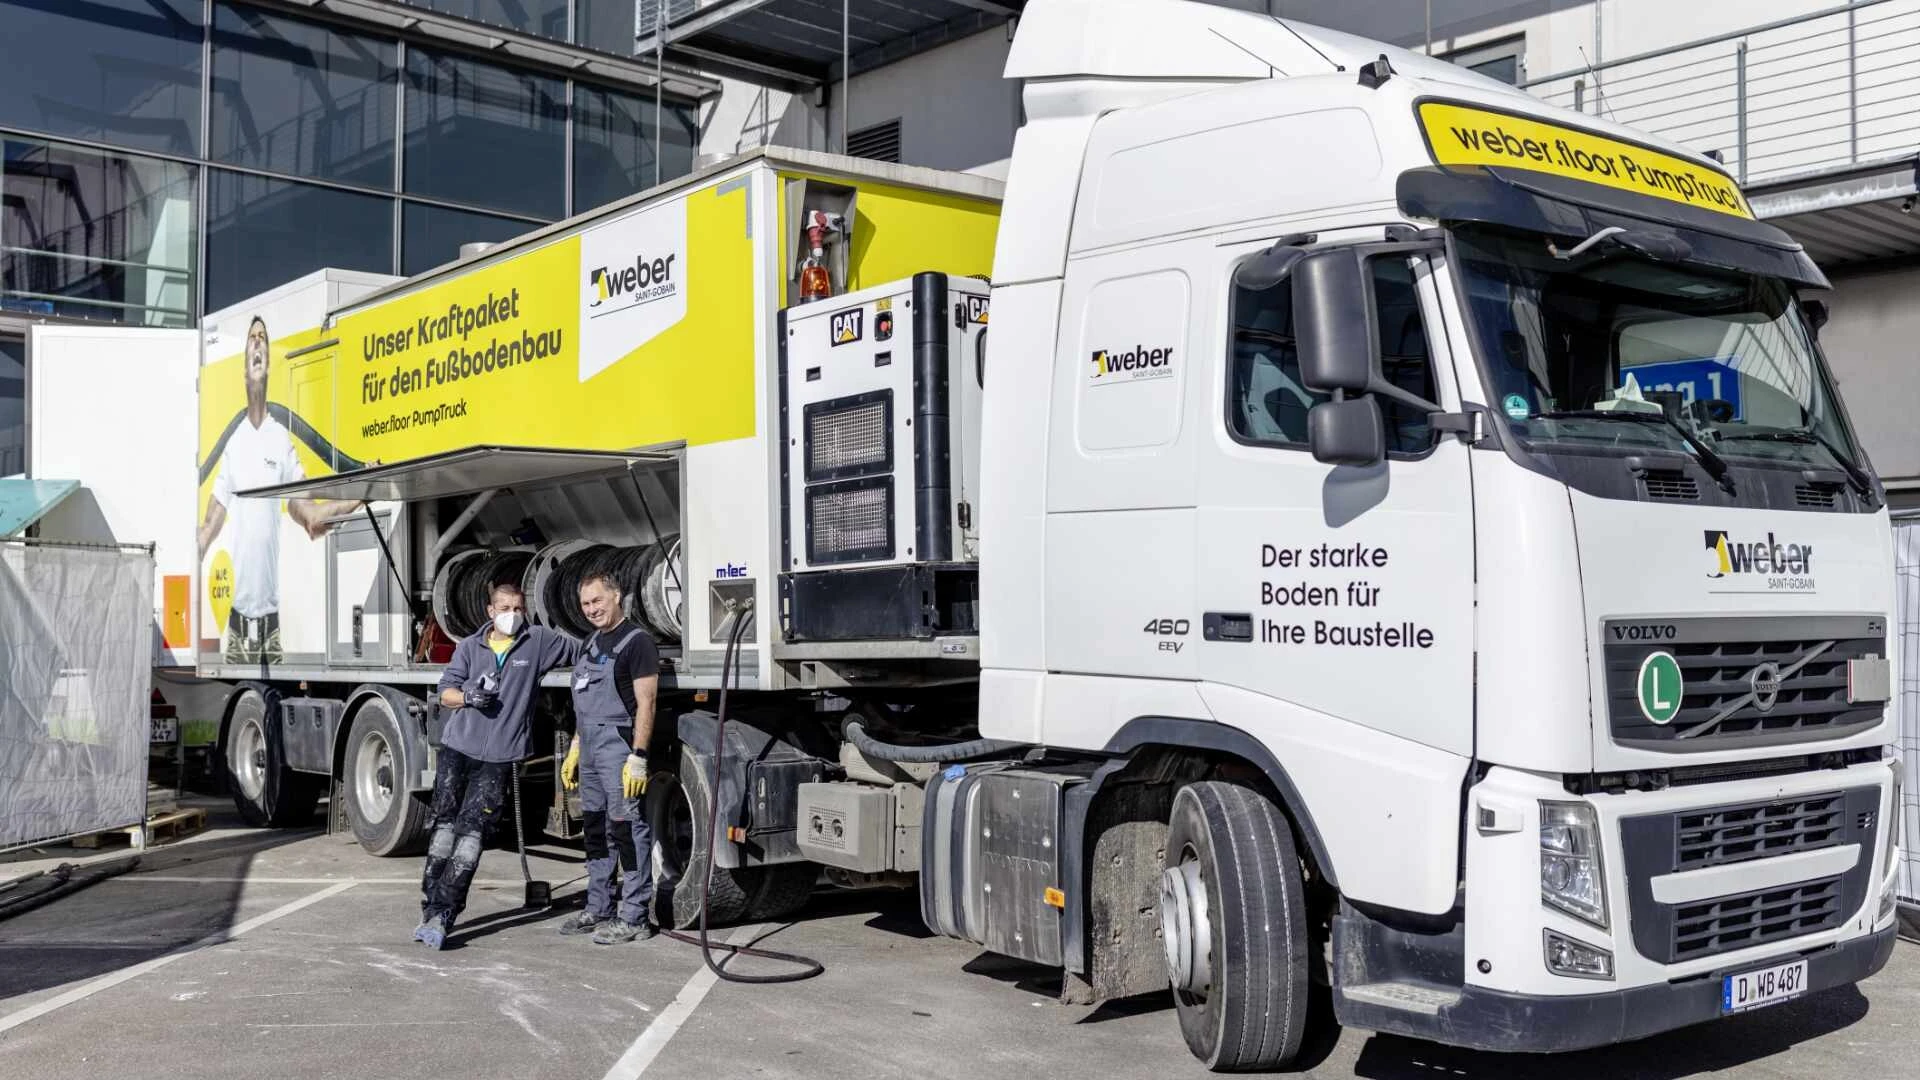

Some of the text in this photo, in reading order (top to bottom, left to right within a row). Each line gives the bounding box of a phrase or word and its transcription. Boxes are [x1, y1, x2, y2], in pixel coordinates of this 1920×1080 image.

[1451, 126, 1744, 213] weber.floor PumpTruck
[606, 253, 675, 298] weber
[634, 281, 676, 303] SAINT-GOBAIN
[363, 287, 520, 362] Unser Kraftpaket
[833, 311, 860, 343] CAT
[362, 328, 562, 404] für den Fußbodenbau
[1106, 344, 1173, 373] weber
[362, 397, 467, 438] weber.floor PumpTruck
[1261, 542, 1388, 568] Der starke
[1727, 531, 1812, 575] weber
[215, 568, 228, 581] we
[1767, 577, 1815, 590] SAINT-GOBAIN
[211, 585, 230, 600] care
[1261, 580, 1381, 607] Boden für
[1143, 618, 1190, 635] 460
[1261, 618, 1434, 649] Ihre Baustelle
[1612, 625, 1677, 640] VOLVO
[1158, 641, 1184, 653] EEV
[1653, 666, 1671, 710] L
[1739, 977, 1748, 1003] D
[1757, 971, 1775, 999] WB
[1778, 964, 1802, 993] 487
